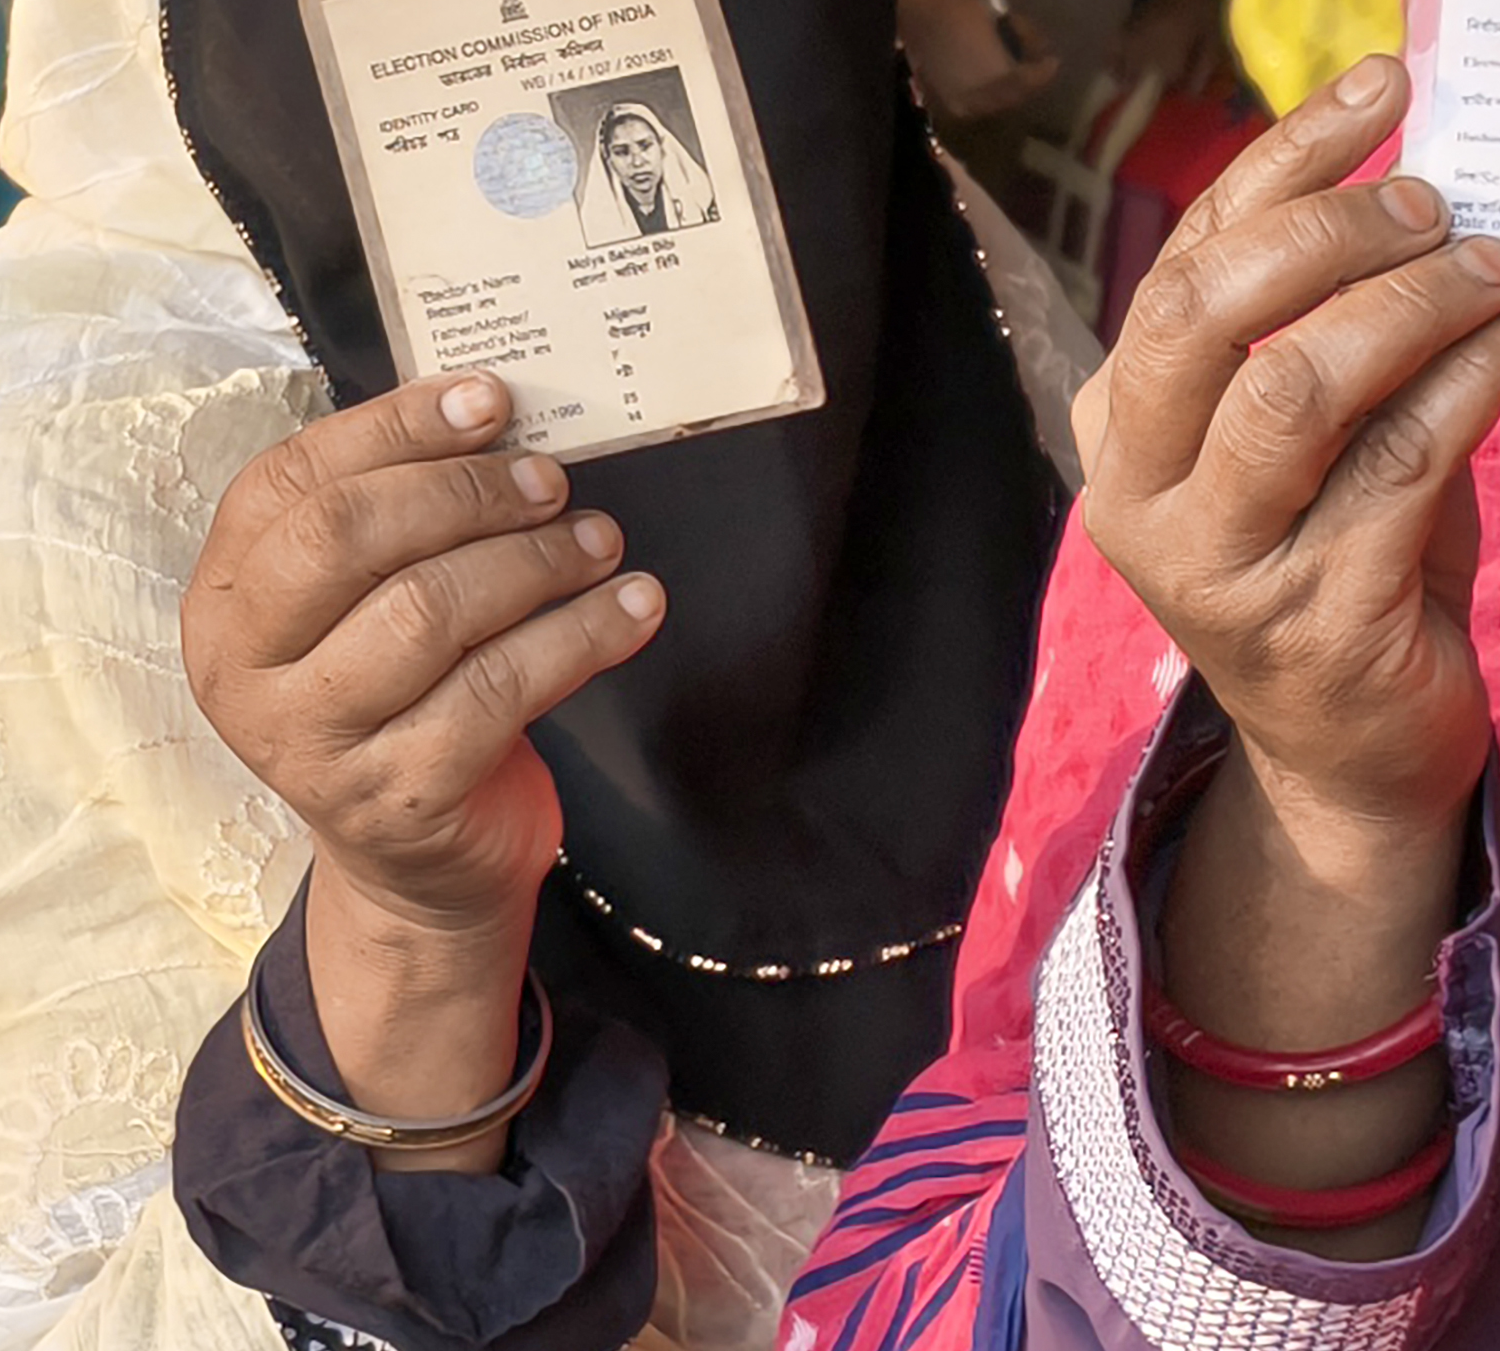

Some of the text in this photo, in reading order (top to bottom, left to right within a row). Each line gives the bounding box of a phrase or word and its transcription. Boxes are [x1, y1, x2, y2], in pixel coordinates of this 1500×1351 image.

[370, 3, 657, 80] ELECTION COMMISSION OF INDIA
[379, 100, 481, 133] IDENTITY CARD
[1451, 212, 1486, 230] Date
[481, 274, 522, 291] Name
[508, 327, 548, 345] Name
